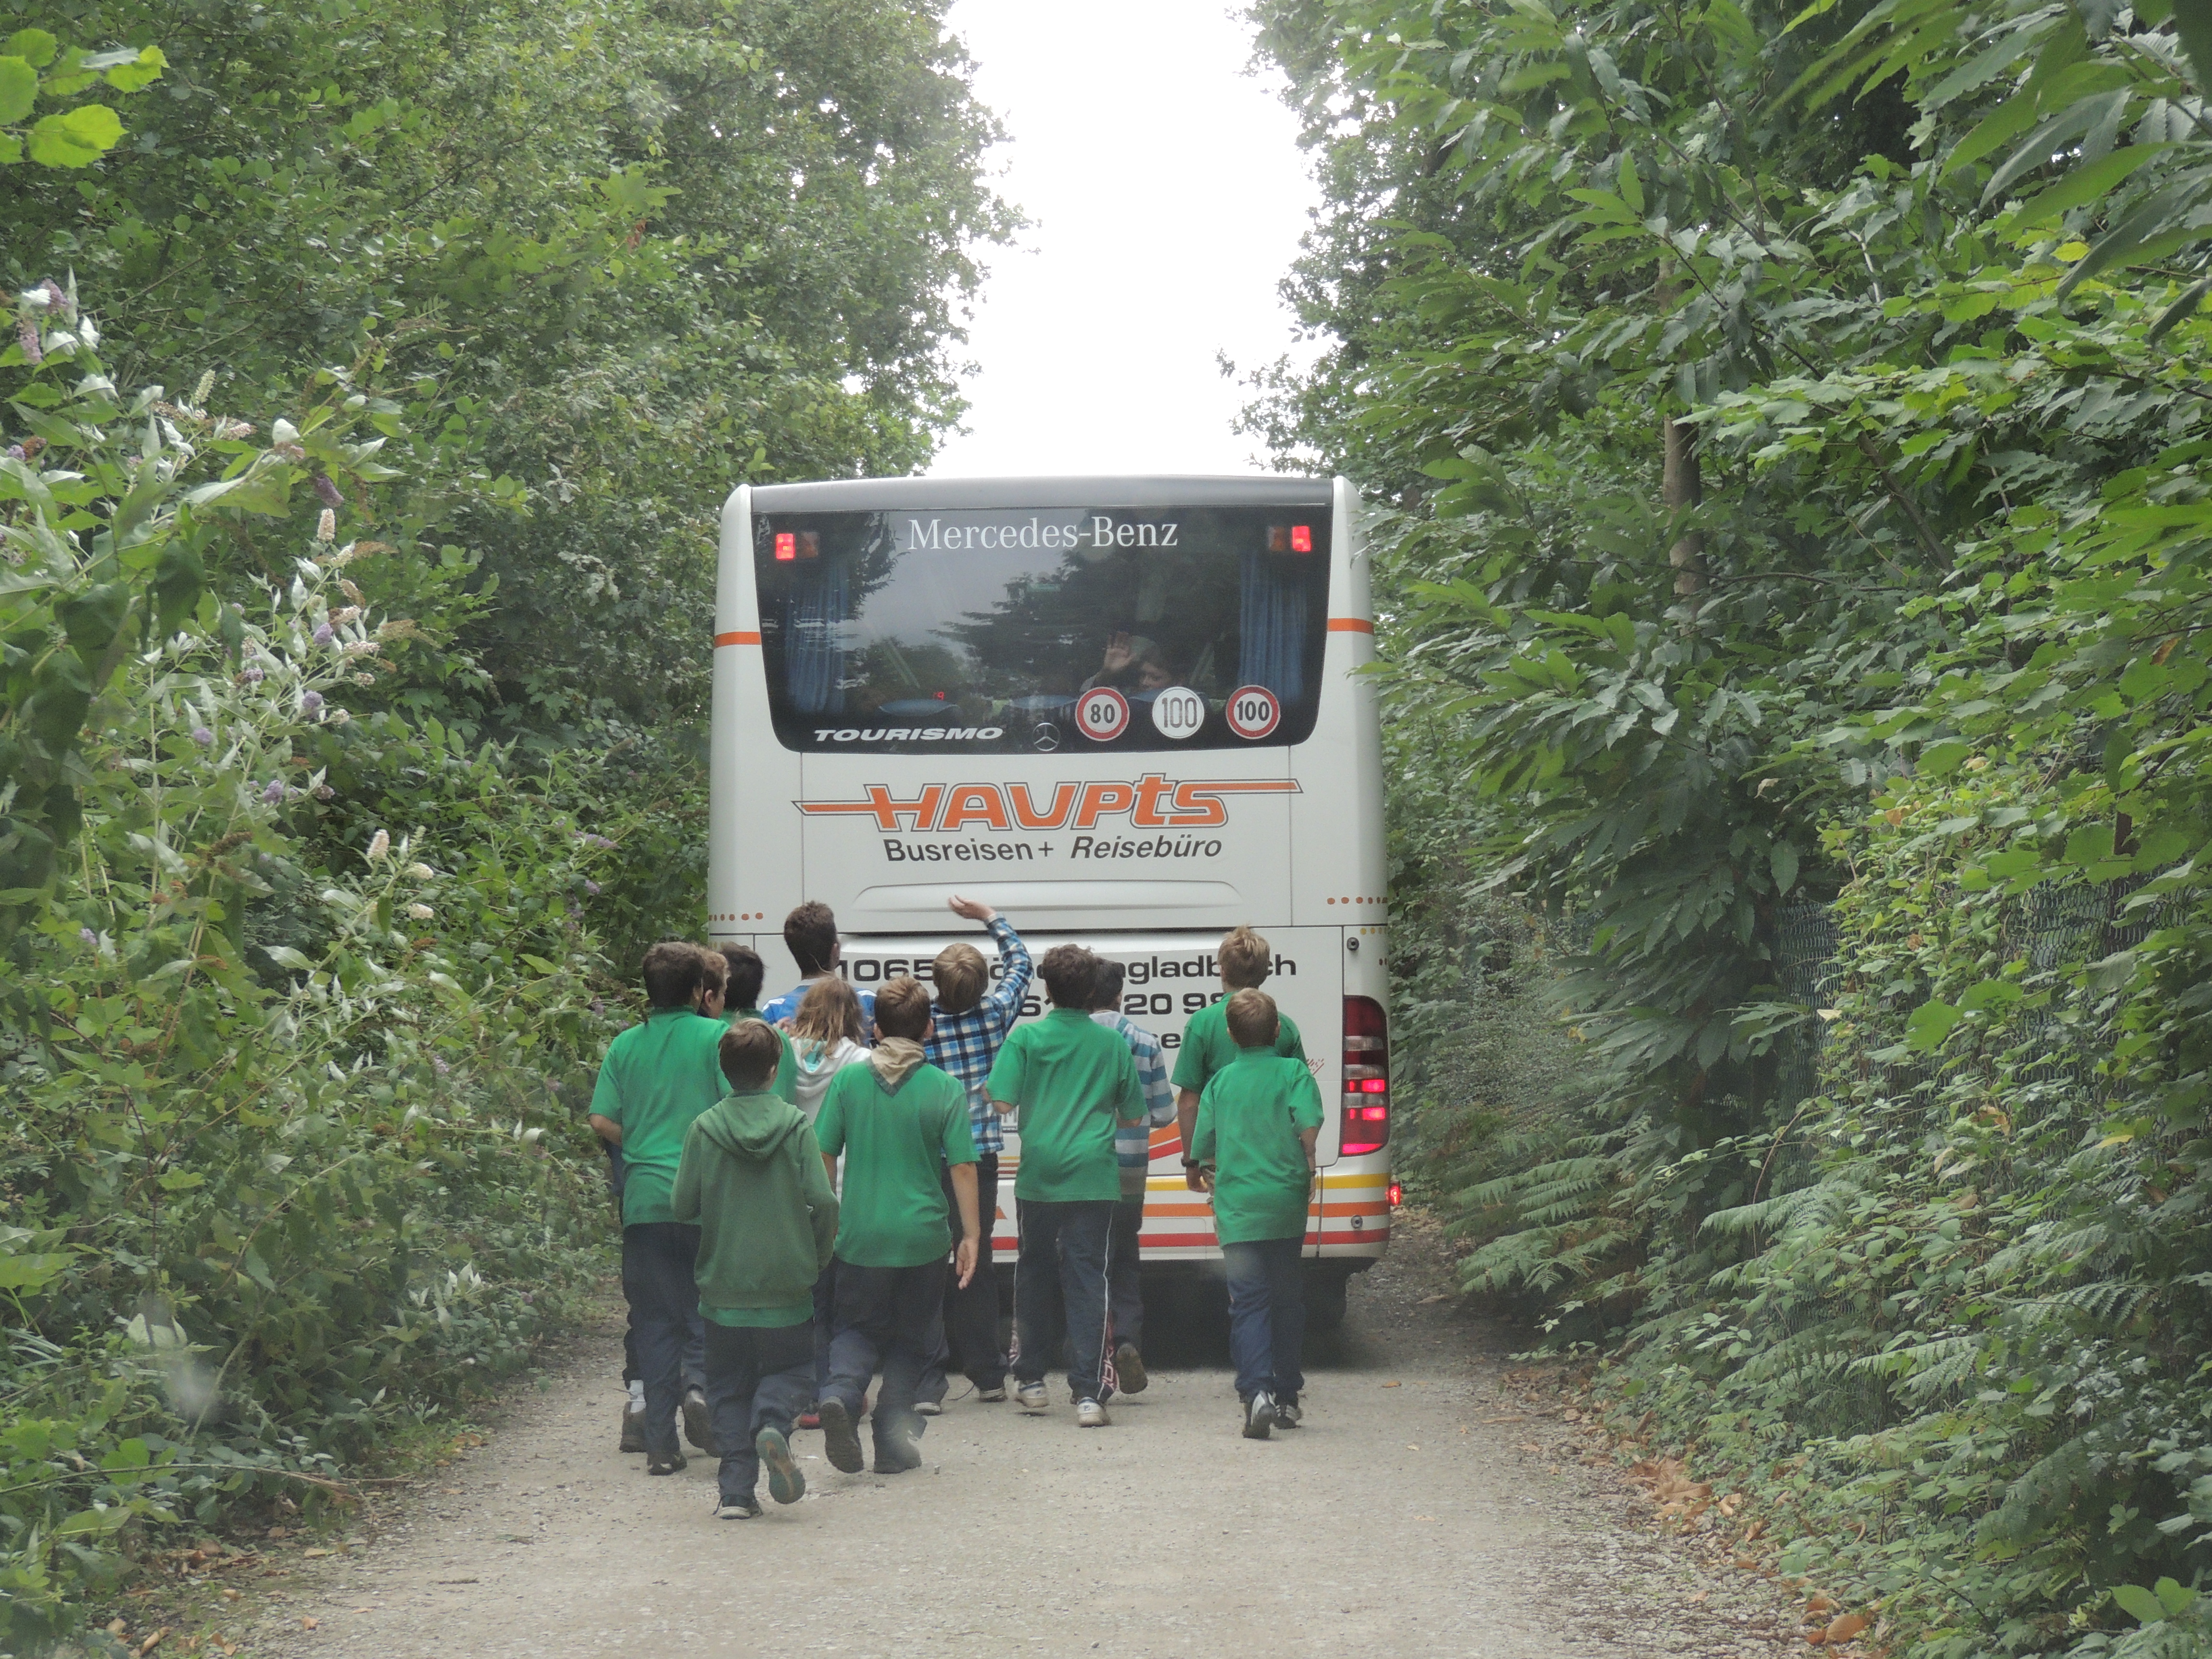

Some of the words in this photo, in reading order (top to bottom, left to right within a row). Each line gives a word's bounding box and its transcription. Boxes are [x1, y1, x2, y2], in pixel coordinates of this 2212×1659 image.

[907, 516, 1178, 550] Mercedes-Benz
[1090, 704, 1115, 724] 80
[1161, 697, 1197, 729] 100
[1237, 700, 1270, 721] 100
[814, 727, 1003, 742] TOURISMO
[1070, 834, 1222, 859] Reisebüro
